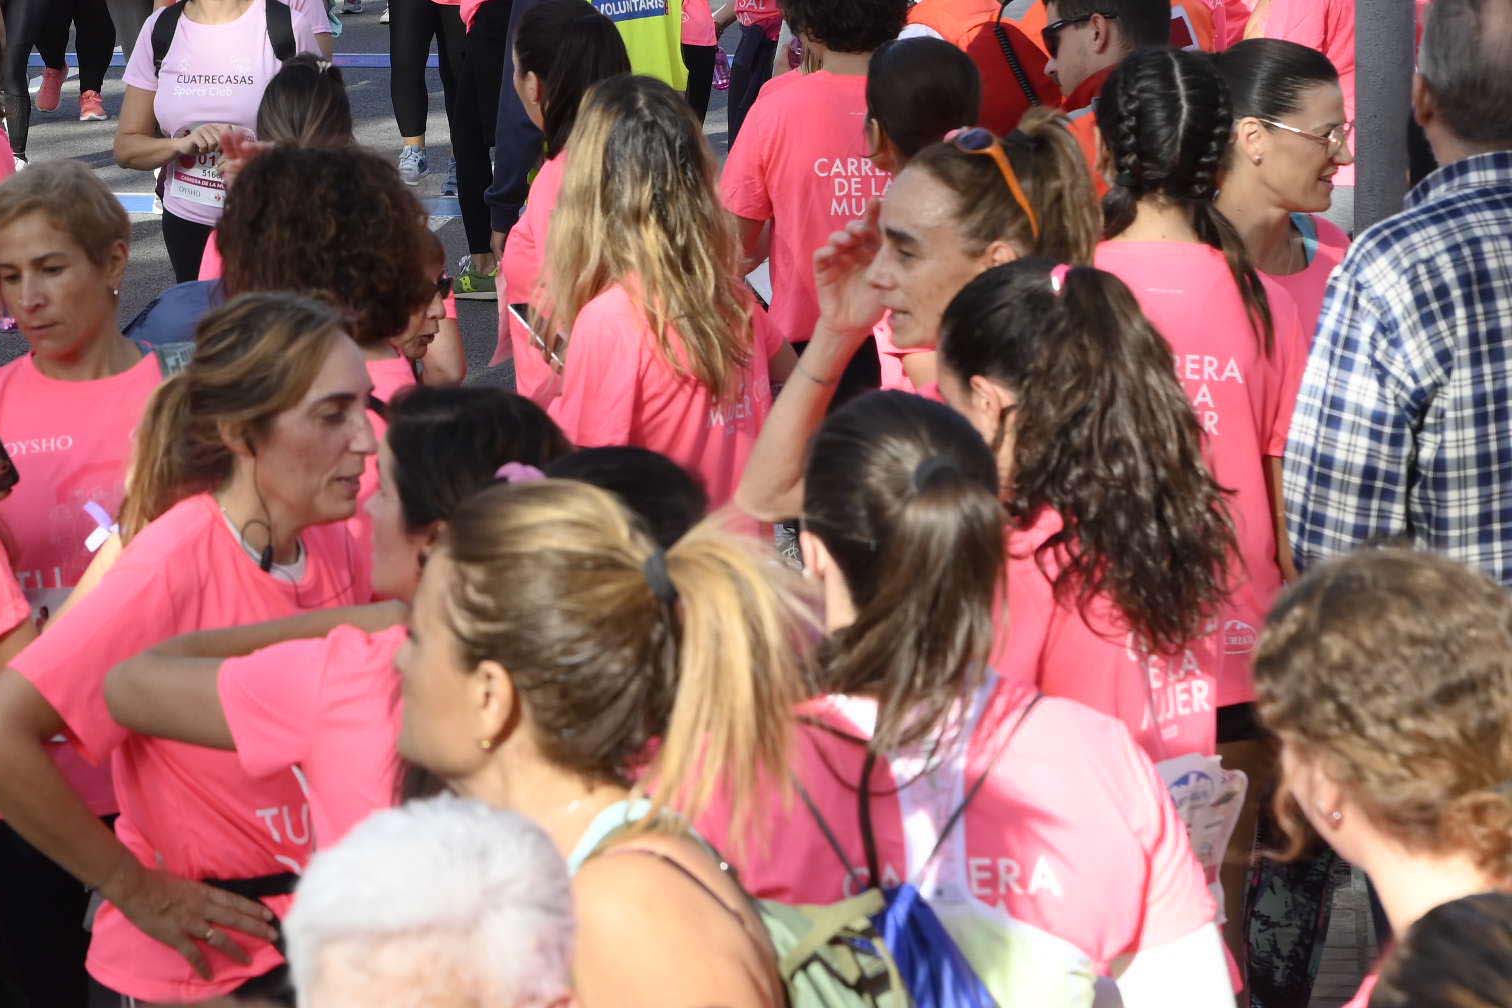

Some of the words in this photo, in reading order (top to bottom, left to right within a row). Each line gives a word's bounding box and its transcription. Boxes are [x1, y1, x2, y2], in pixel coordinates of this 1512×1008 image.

[176, 74, 255, 85] CUATRECASAS
[198, 153, 217, 166] 01
[834, 178, 862, 195] DE
[4, 435, 73, 457] OYSHO
